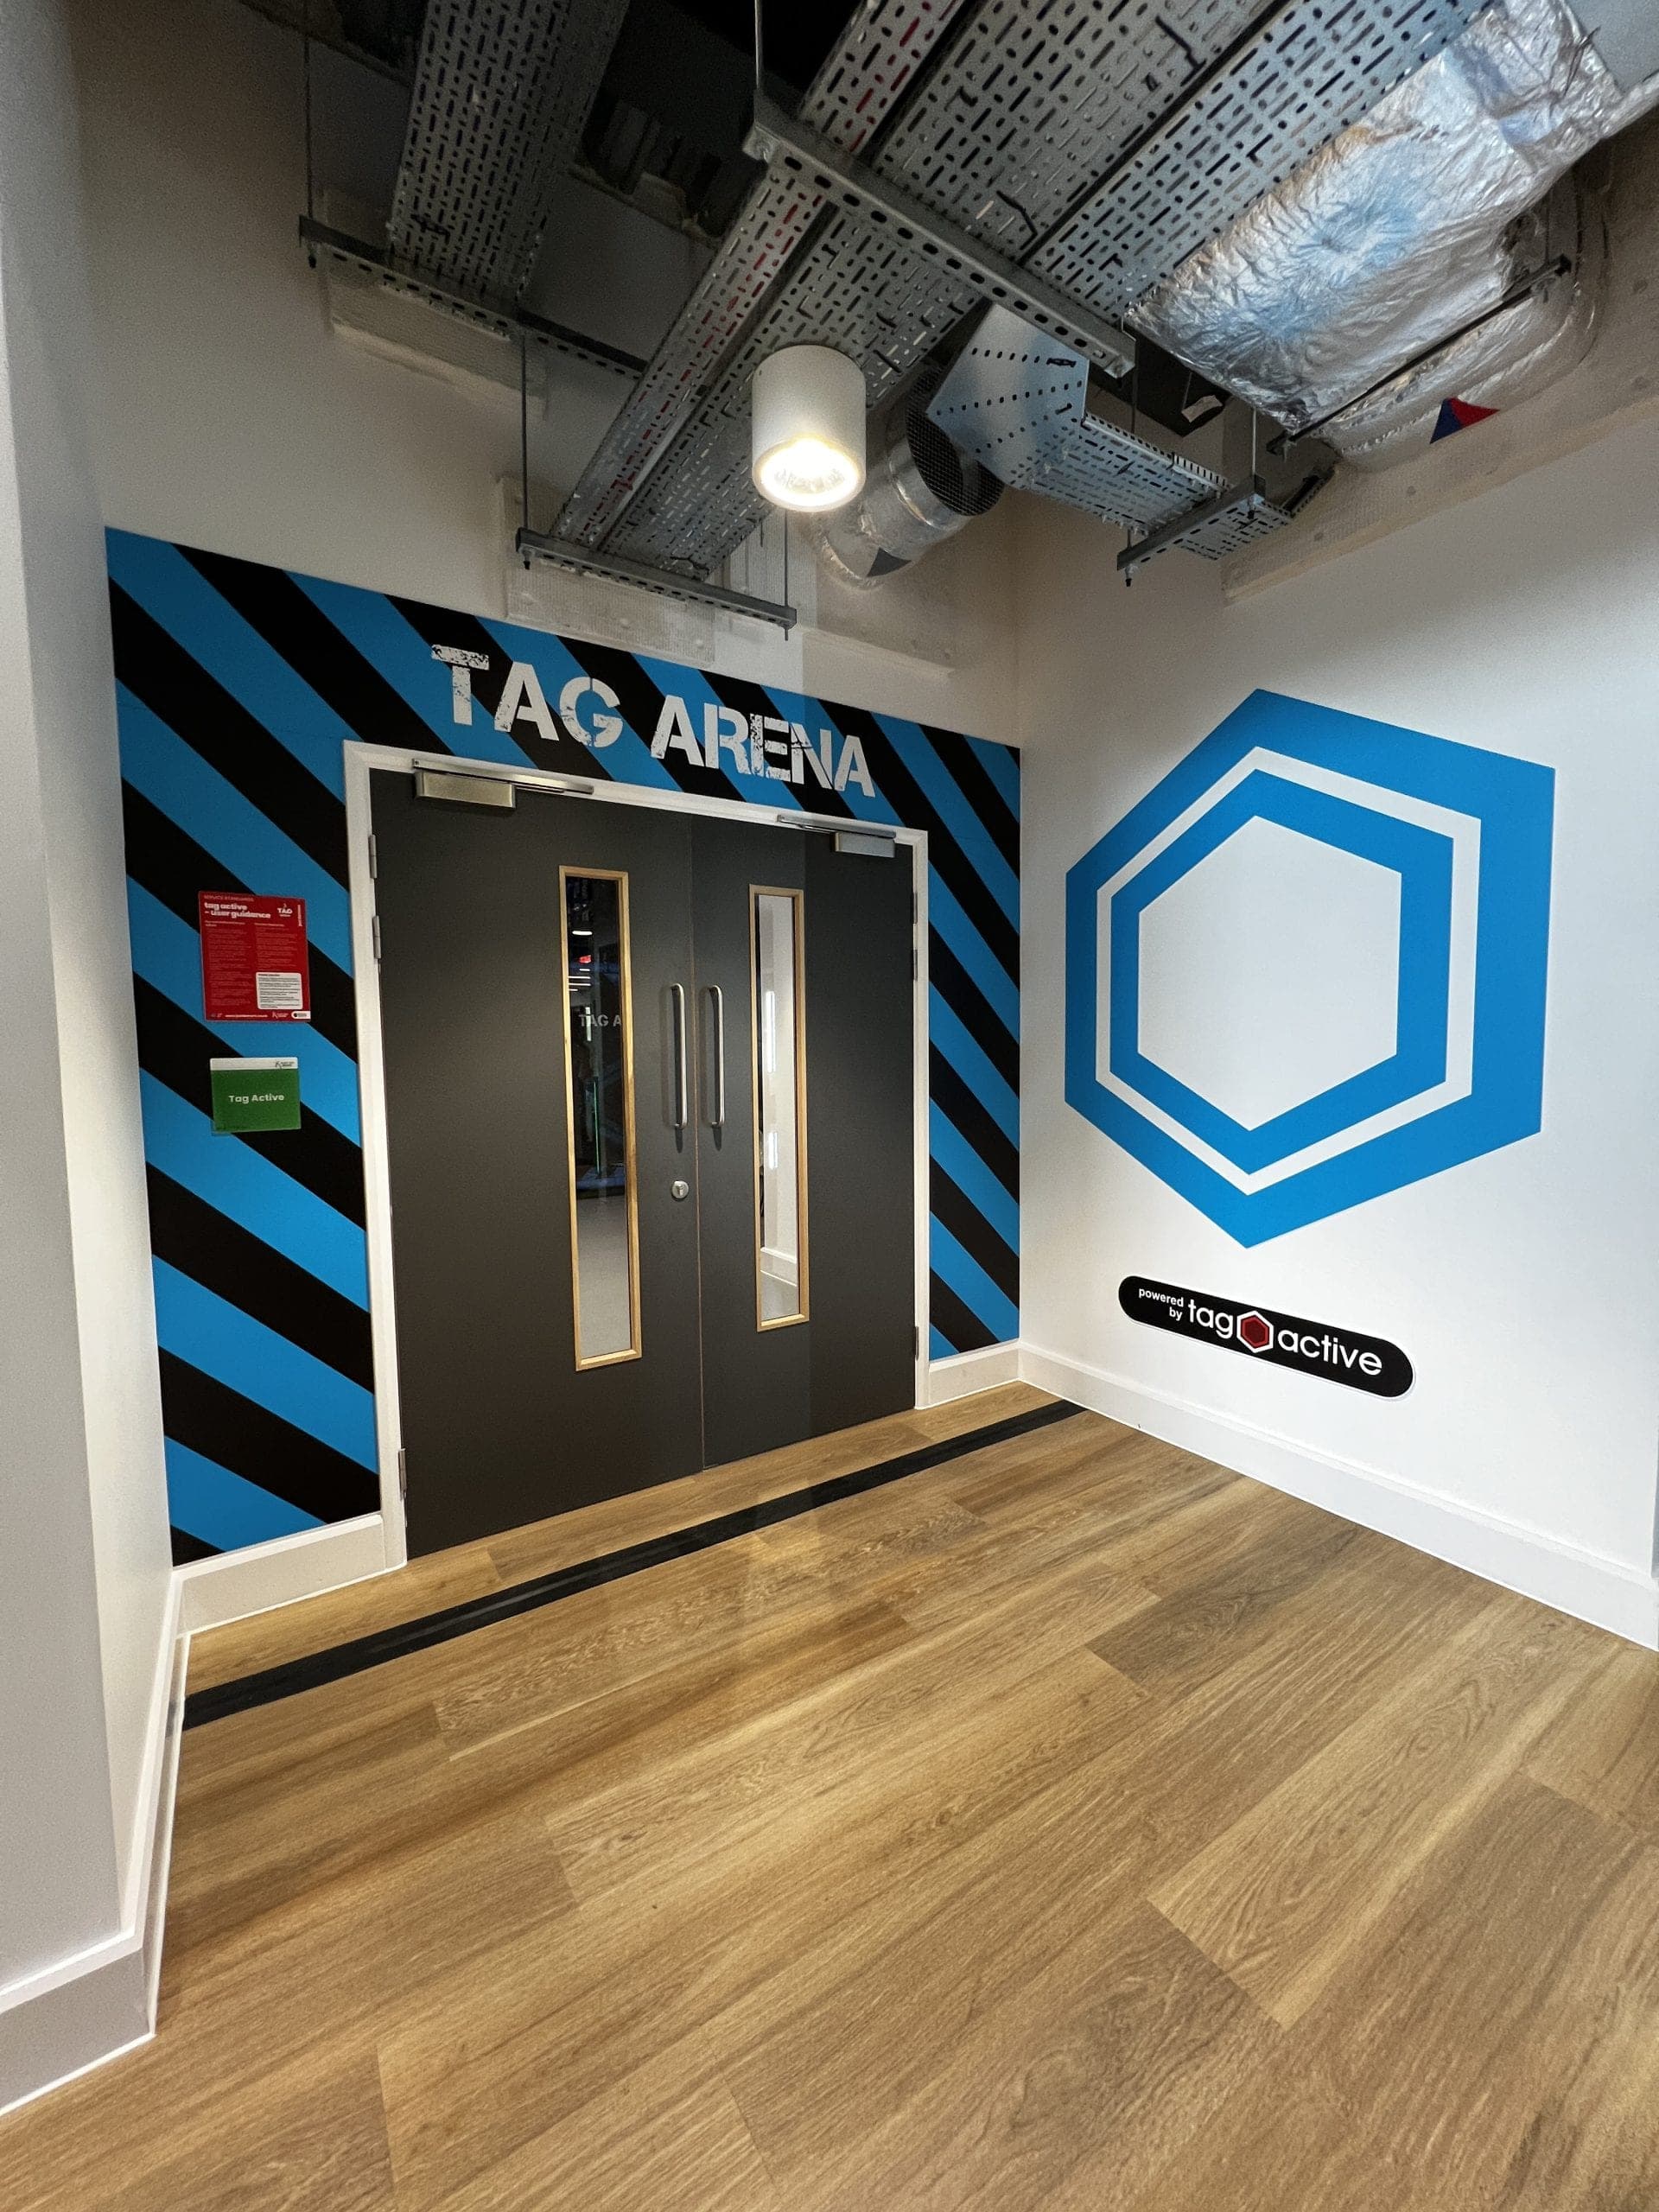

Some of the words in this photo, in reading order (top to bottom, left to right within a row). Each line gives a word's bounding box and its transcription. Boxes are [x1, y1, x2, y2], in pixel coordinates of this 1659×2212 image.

[431, 644, 623, 748] TAG
[650, 695, 876, 798] ARENA
[204, 902, 220, 911] tag
[228, 1095, 250, 1104] Tag
[251, 1093, 285, 1103] Active
[1138, 1287, 1184, 1307] powered
[1169, 1306, 1183, 1321] by
[1188, 1299, 1234, 1339] tag
[1277, 1329, 1383, 1376] active
